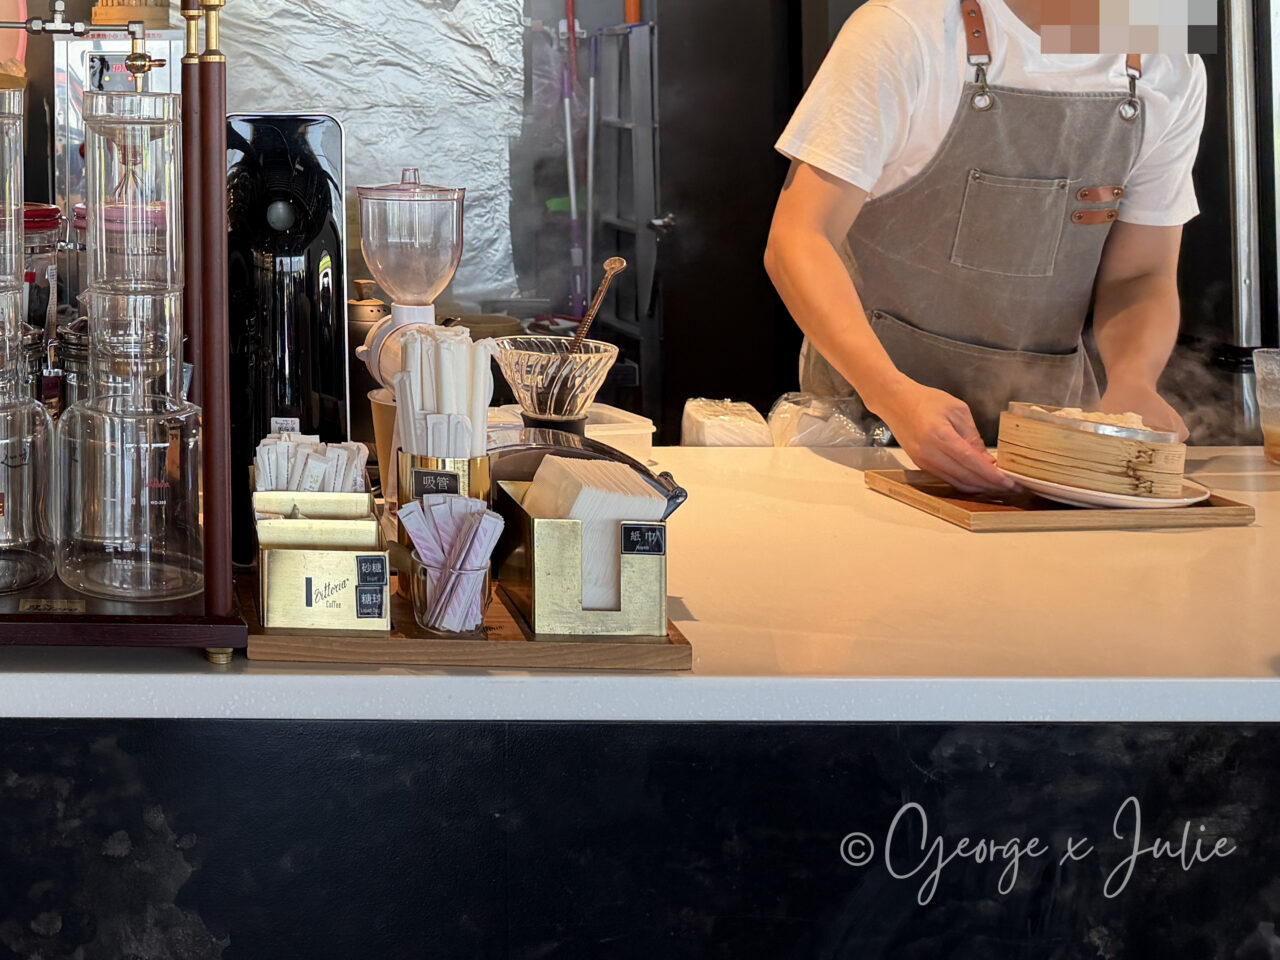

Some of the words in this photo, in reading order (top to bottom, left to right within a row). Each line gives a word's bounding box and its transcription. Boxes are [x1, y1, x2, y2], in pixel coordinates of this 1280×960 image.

[423, 476, 450, 490] 吸管
[630, 530, 656, 542] 紙巾
[362, 563, 382, 573] 砂糖
